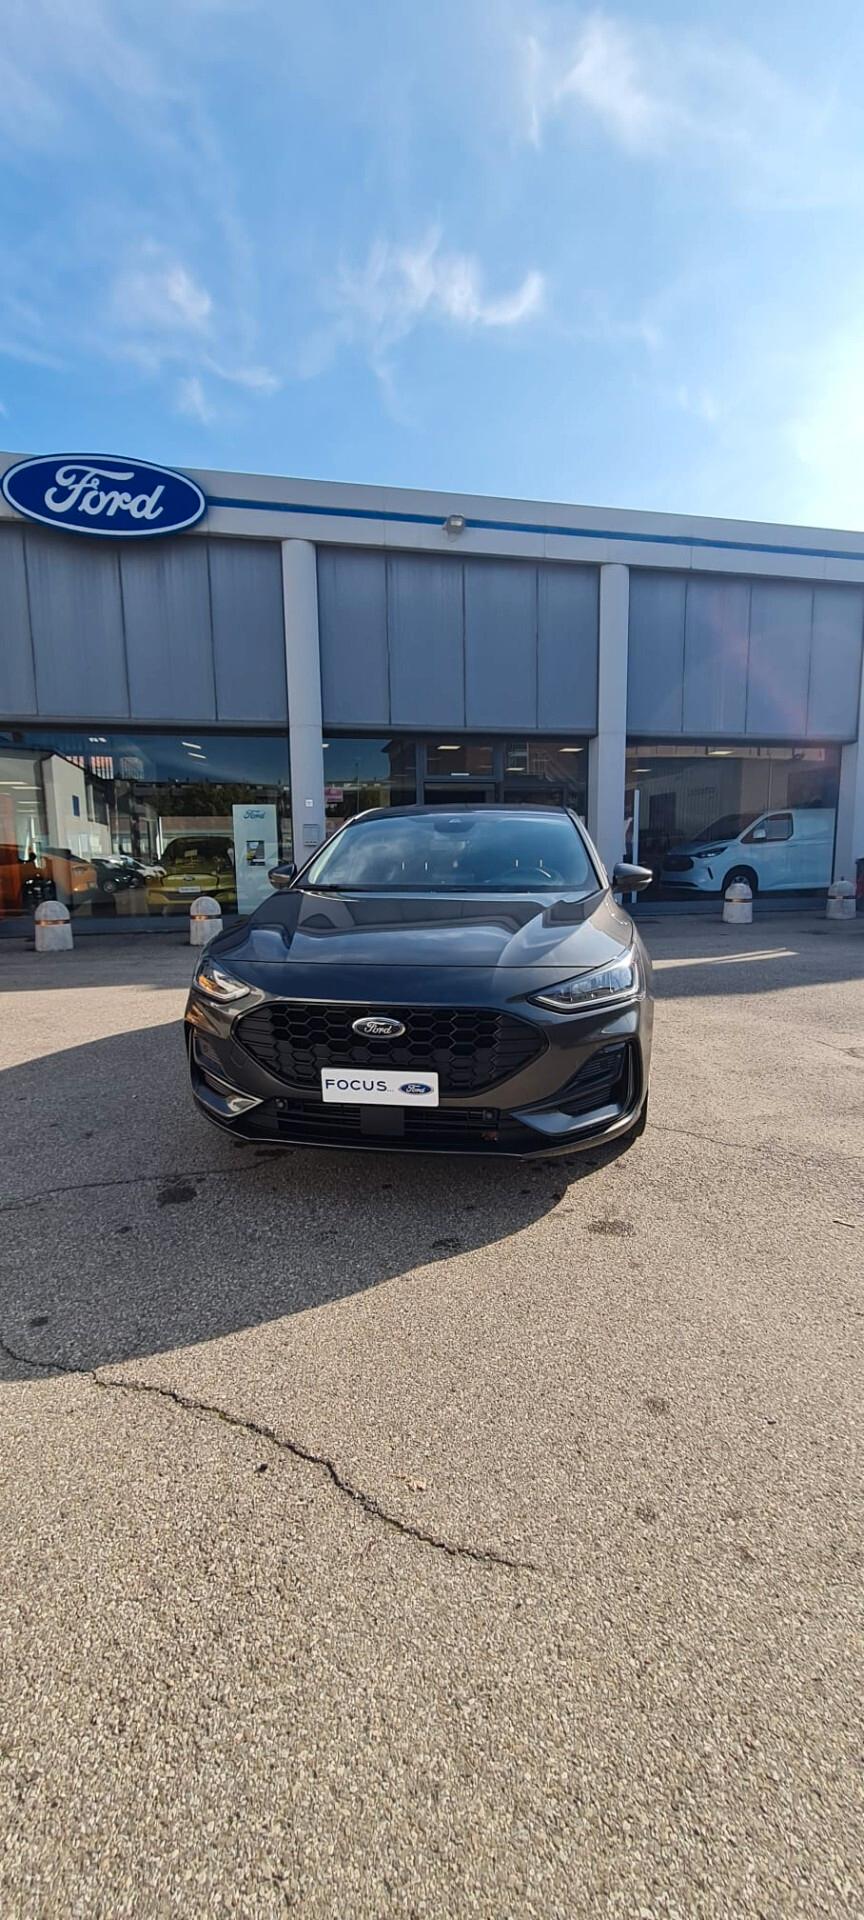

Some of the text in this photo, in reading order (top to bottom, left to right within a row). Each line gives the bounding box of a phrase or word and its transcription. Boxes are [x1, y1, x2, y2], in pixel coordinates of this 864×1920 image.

[44, 464, 166, 520] Ford
[243, 809, 266, 820] Ford
[364, 1021, 393, 1035] Ford
[325, 1079, 388, 1092] FOCUS
[406, 1084, 426, 1093] Ford
